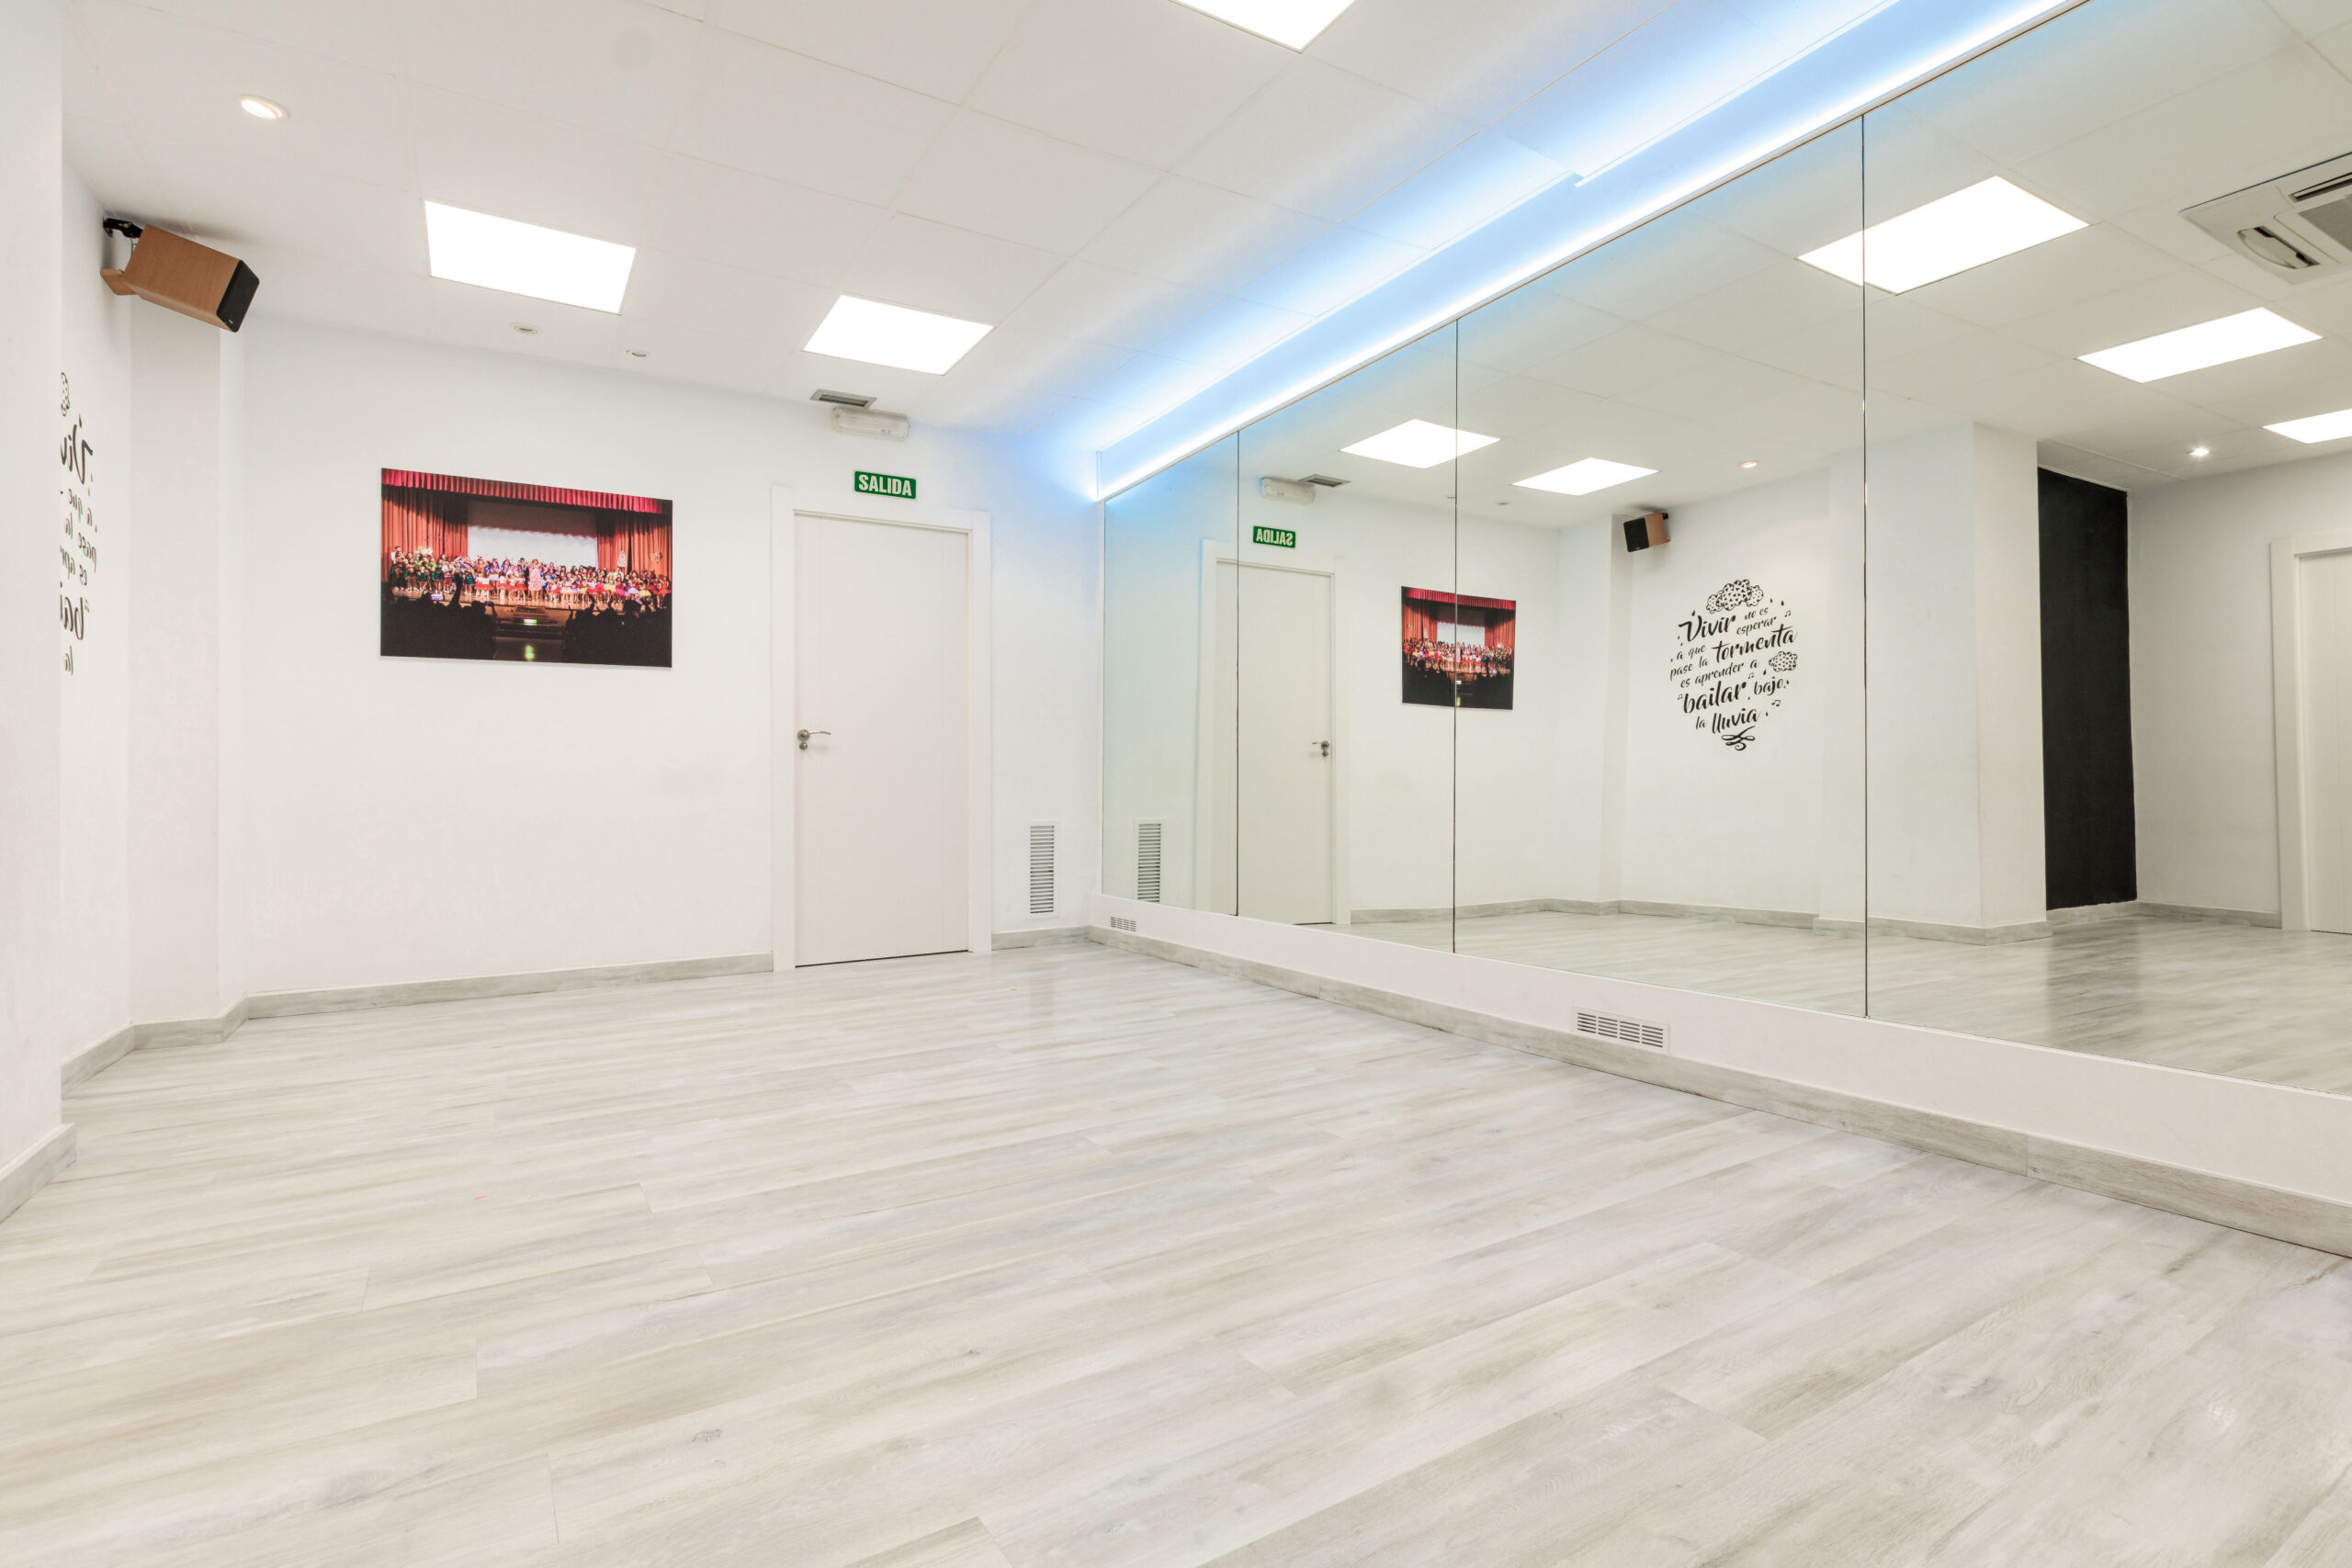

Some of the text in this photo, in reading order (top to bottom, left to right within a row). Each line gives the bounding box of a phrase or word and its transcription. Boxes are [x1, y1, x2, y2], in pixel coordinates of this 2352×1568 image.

[858, 474, 912, 496] SALIDA
[1679, 606, 1769, 642] Vivir no es
[1736, 616, 1777, 637] esperar
[1676, 623, 1798, 663] a que tormenta
[1669, 655, 1708, 681] pase la
[1680, 659, 1758, 688] es aprender a
[1683, 680, 1747, 714] bailar
[1696, 707, 1758, 734] la lluvia
